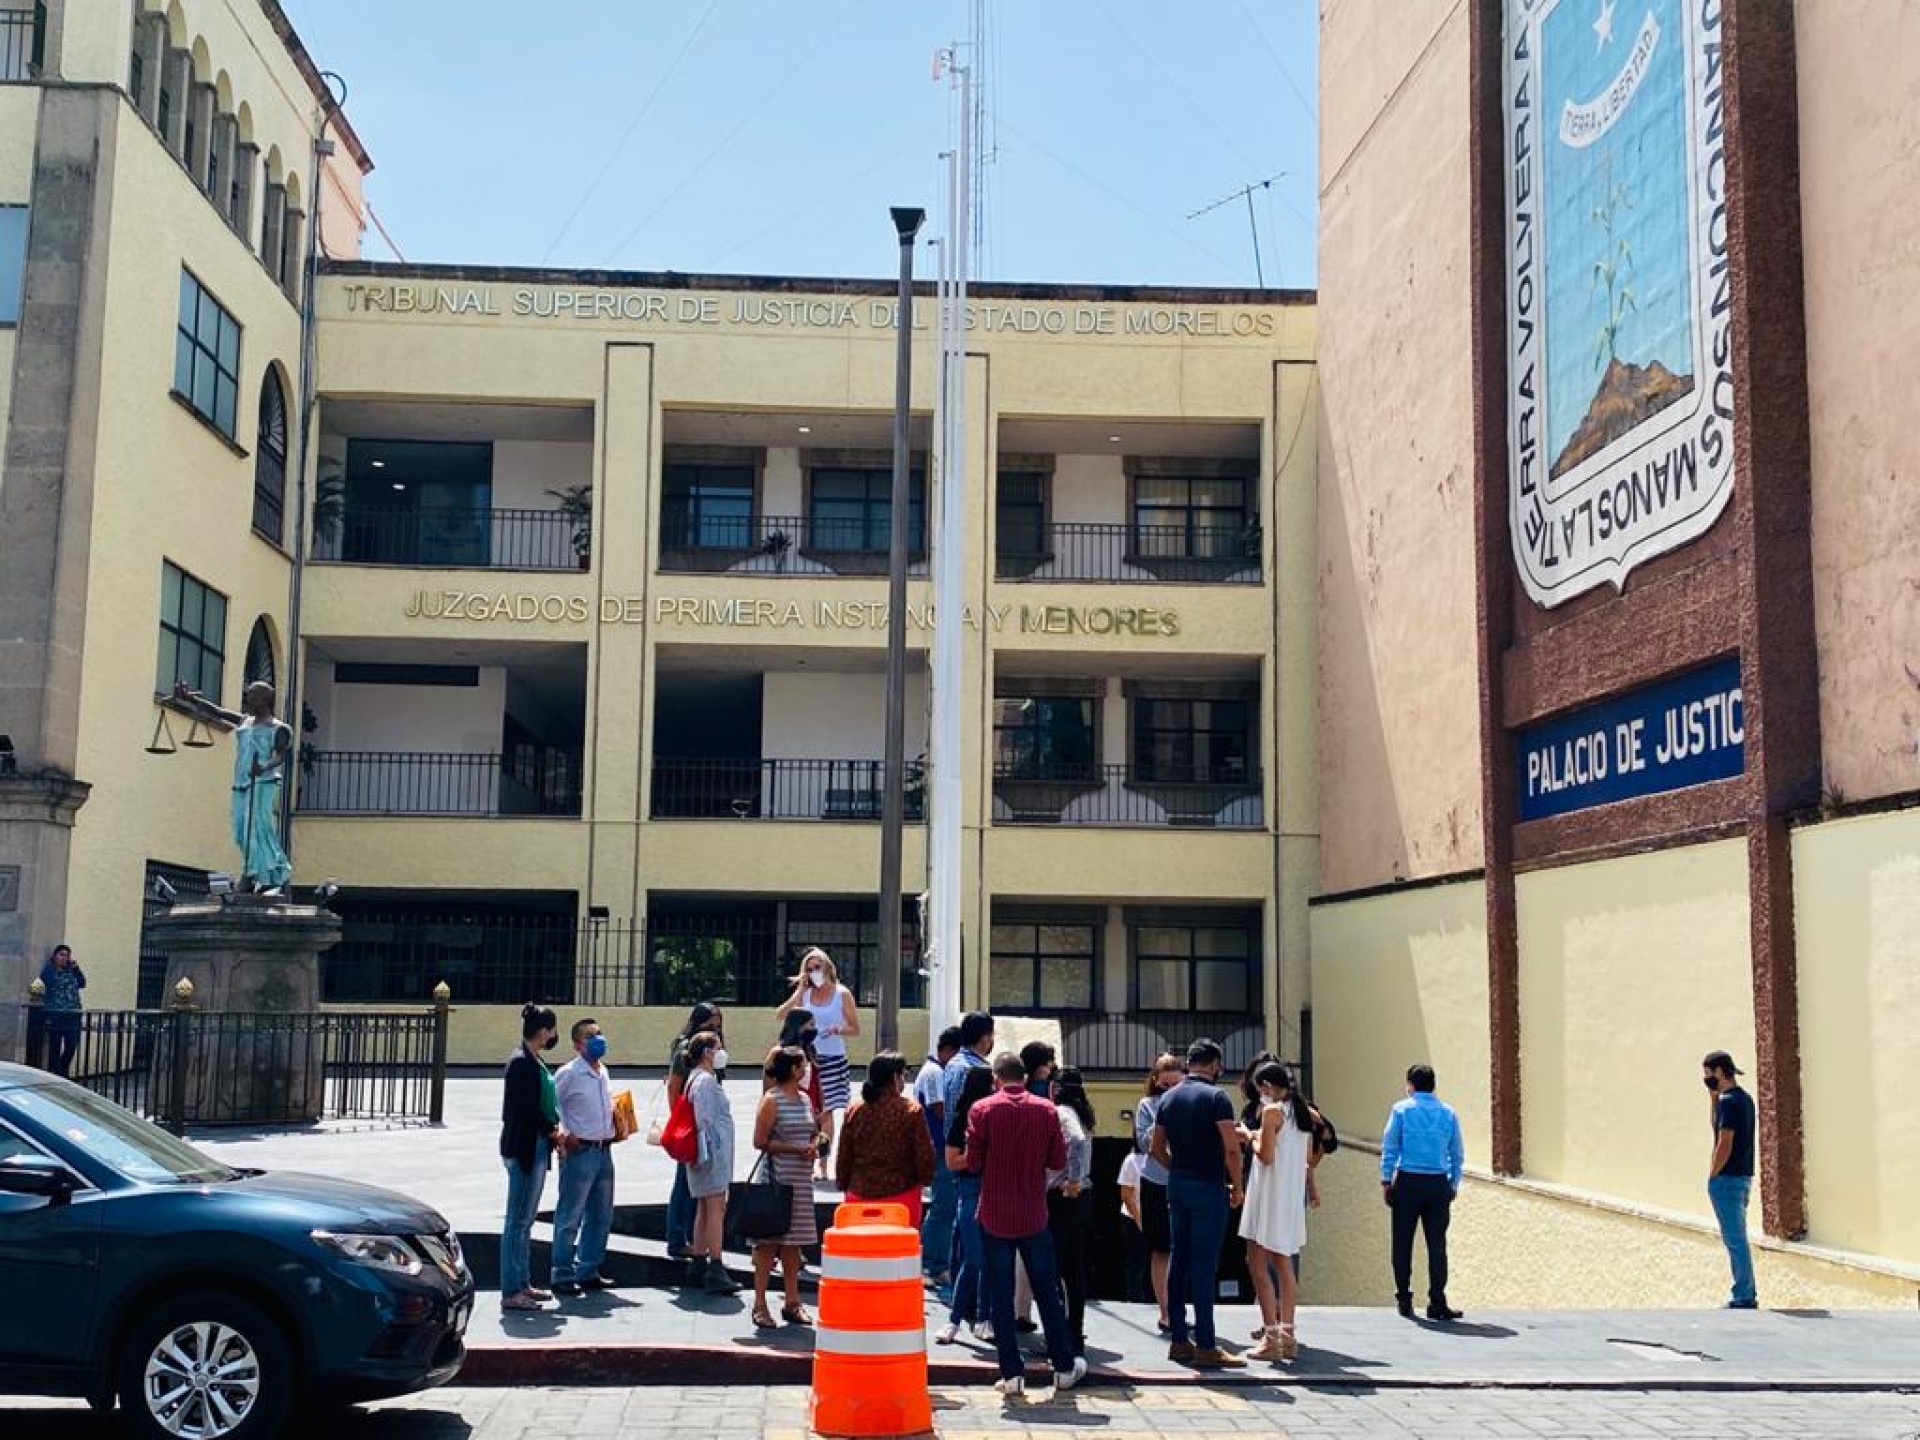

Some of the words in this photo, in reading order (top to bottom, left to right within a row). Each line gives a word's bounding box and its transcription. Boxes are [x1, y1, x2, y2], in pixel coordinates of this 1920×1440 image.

[1514, 70, 1534, 356] VOLVERA
[343, 285, 500, 315] TRIBUNAL
[512, 289, 668, 321] SUPERIOR
[677, 297, 722, 323] DE
[728, 299, 859, 328] JUSTICIA
[1075, 308, 1115, 334] DE
[1125, 309, 1275, 336] MORELOS
[1598, 437, 1698, 540] MANOS
[405, 590, 589, 622] JUZGADOS
[600, 598, 644, 624] DE
[654, 599, 804, 627] PRIMERA
[813, 601, 978, 630] INSTNA
[988, 603, 1011, 632] Y
[1020, 605, 1181, 636] MENORES
[1528, 731, 1608, 797] PALACIO
[1616, 719, 1646, 775] DE
